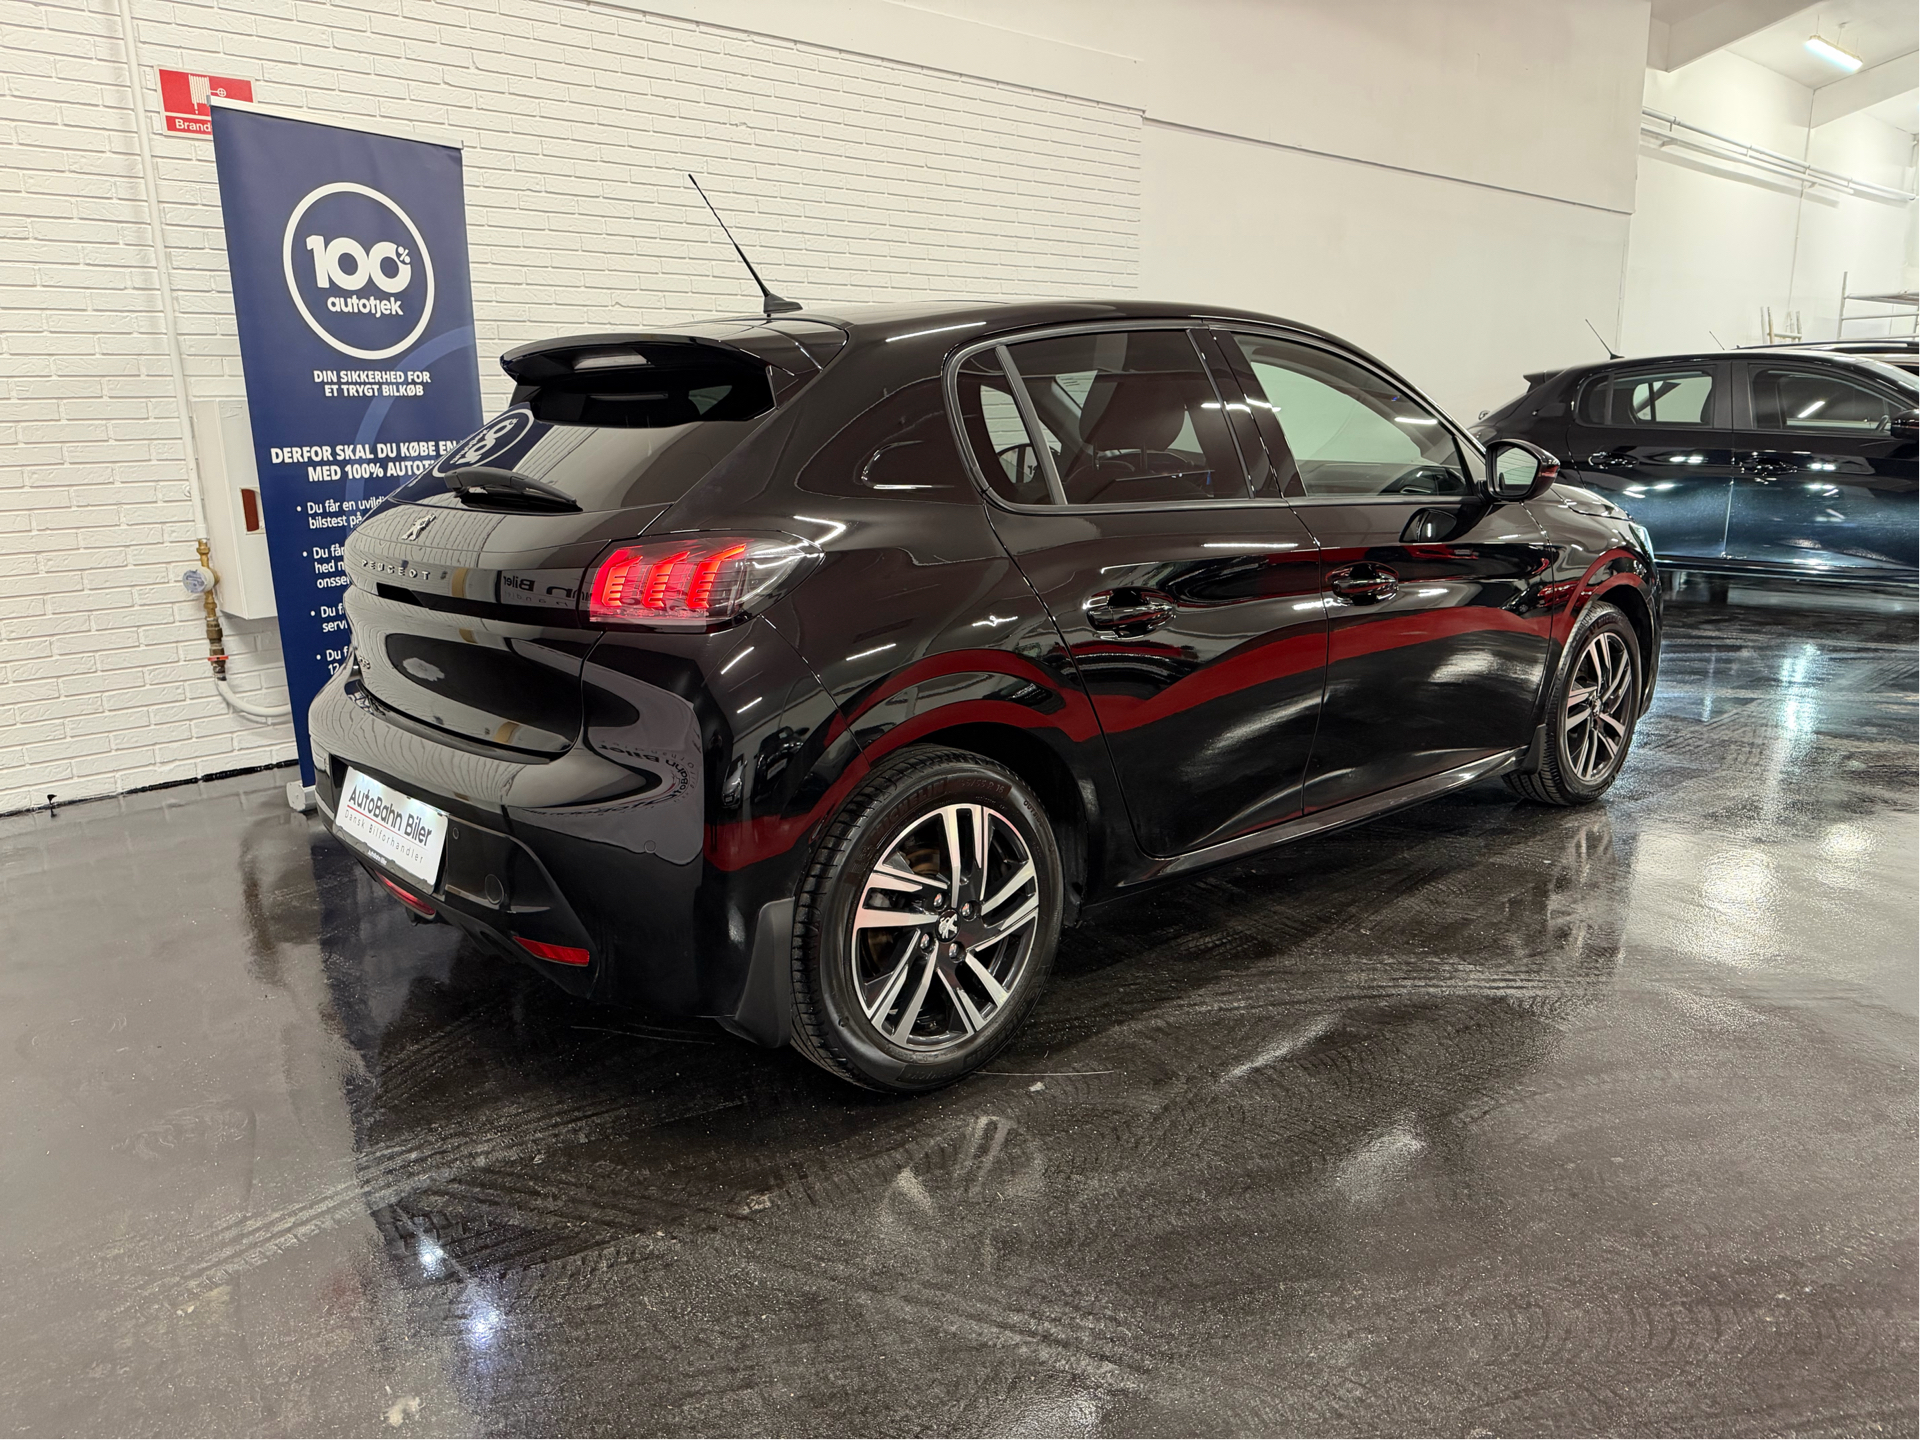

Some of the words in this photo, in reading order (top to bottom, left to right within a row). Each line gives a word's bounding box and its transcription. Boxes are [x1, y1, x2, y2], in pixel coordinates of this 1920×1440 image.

[175, 119, 212, 132] Brand
[306, 235, 412, 293] 100%
[327, 295, 403, 318] autotjek
[313, 370, 337, 383] DIN
[340, 371, 404, 383] SIKKERHED
[407, 371, 431, 383] FOR
[324, 385, 338, 397] ET
[341, 385, 378, 397] TRYGT
[382, 385, 424, 397] BILKØB
[270, 446, 333, 464] DERFOR
[335, 443, 374, 460] SKAL
[376, 442, 397, 458] DU
[400, 441, 436, 457] KØBE
[438, 440, 457, 455] EN
[307, 465, 341, 482] MED
[344, 462, 384, 479] 100%
[386, 459, 435, 477] AUTOT
[307, 501, 323, 514] Du
[325, 498, 340, 512] får
[342, 500, 356, 511] en
[358, 496, 384, 510] uvild
[308, 515, 347, 529] bilstest
[349, 511, 362, 528] på
[313, 547, 328, 559] Du
[330, 543, 345, 557] får
[314, 560, 335, 574] hed
[361, 559, 430, 581] PEUGEOT
[320, 605, 336, 618] Du
[338, 602, 345, 615] f
[325, 649, 341, 662] Du
[327, 662, 340, 676] 12
[349, 785, 403, 832] AutoBahn
[404, 813, 432, 847] Biler
[344, 809, 366, 829] Dansk
[368, 825, 424, 863] Bilforhandler
